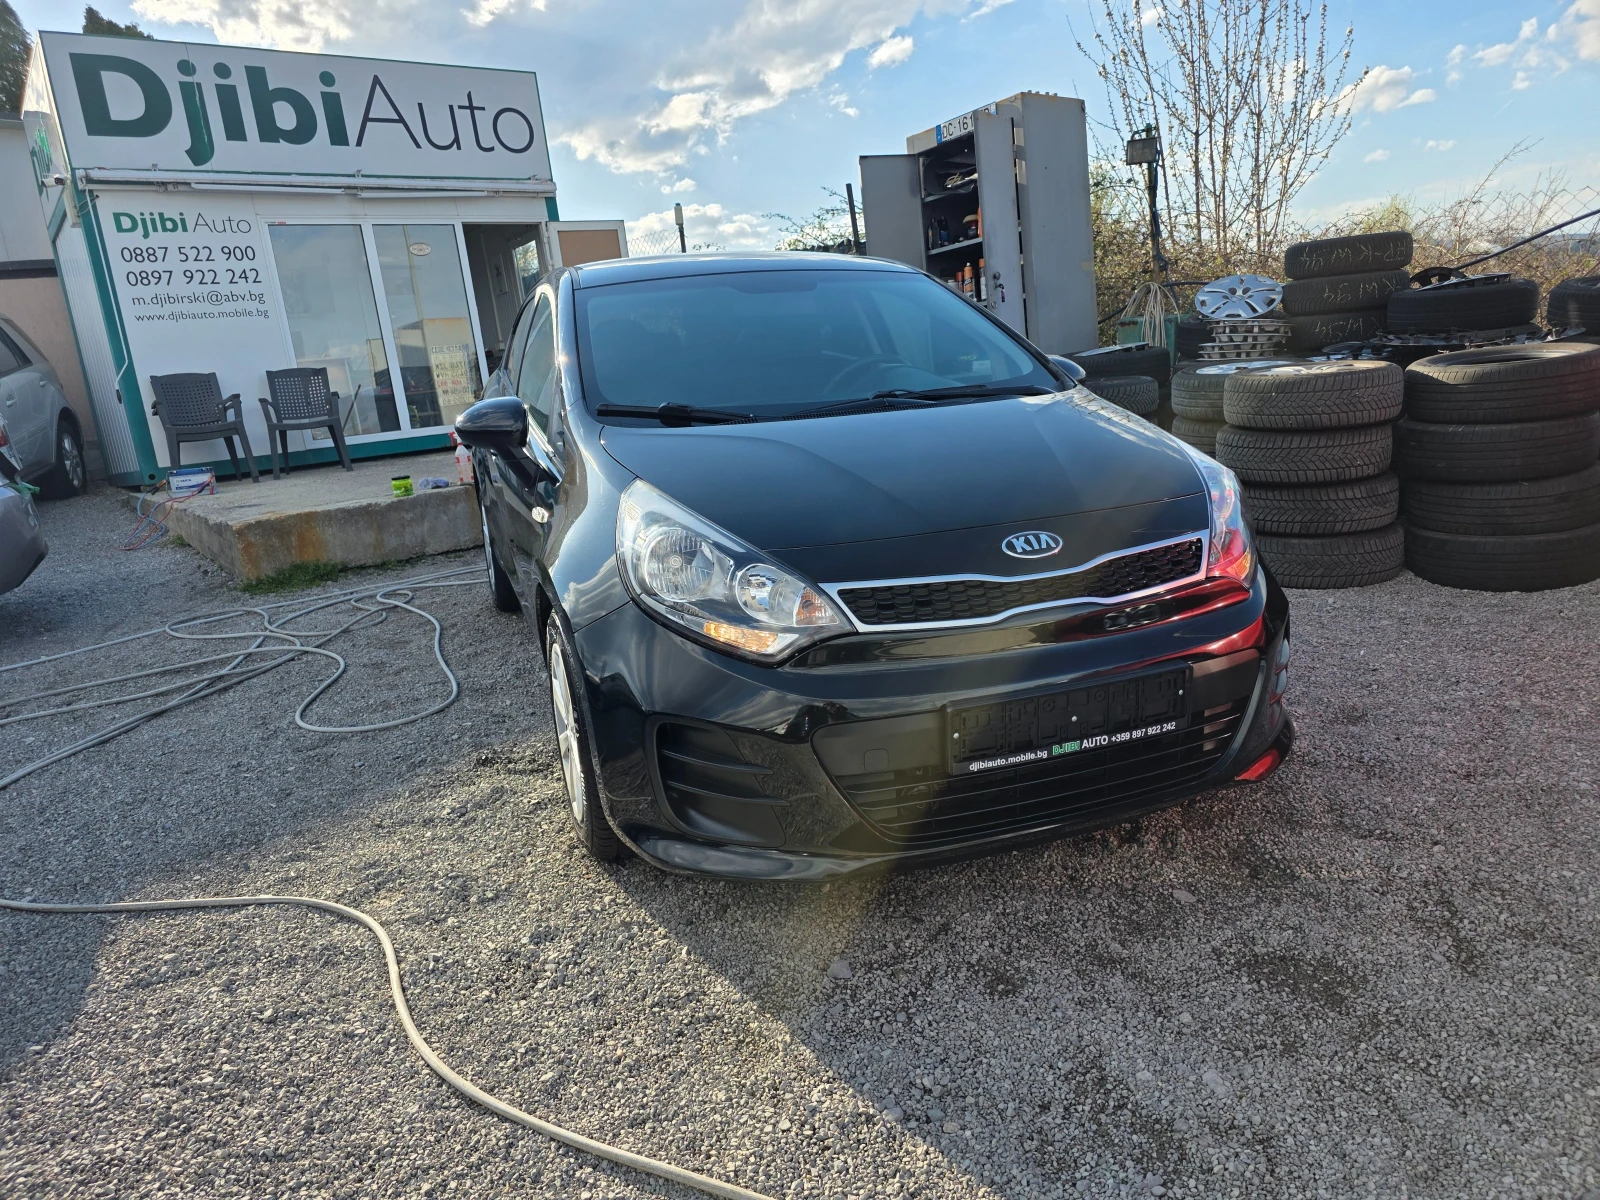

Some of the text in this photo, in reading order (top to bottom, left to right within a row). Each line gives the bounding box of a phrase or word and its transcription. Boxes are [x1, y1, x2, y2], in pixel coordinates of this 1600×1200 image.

[69, 52, 535, 167] Djibi Auto
[112, 212, 252, 240] Djibi Auto
[120, 245, 257, 263] 0887 522 900
[126, 268, 262, 287] 0897 922 242
[131, 290, 266, 308] m.djibirski@abv.bg
[134, 307, 270, 323] www.djibiauto.mobile.bg
[1010, 533, 1057, 553] KIA
[969, 721, 1176, 771] djibiauto.mobile.bg DJIBI AUTO +359 897 922 242
